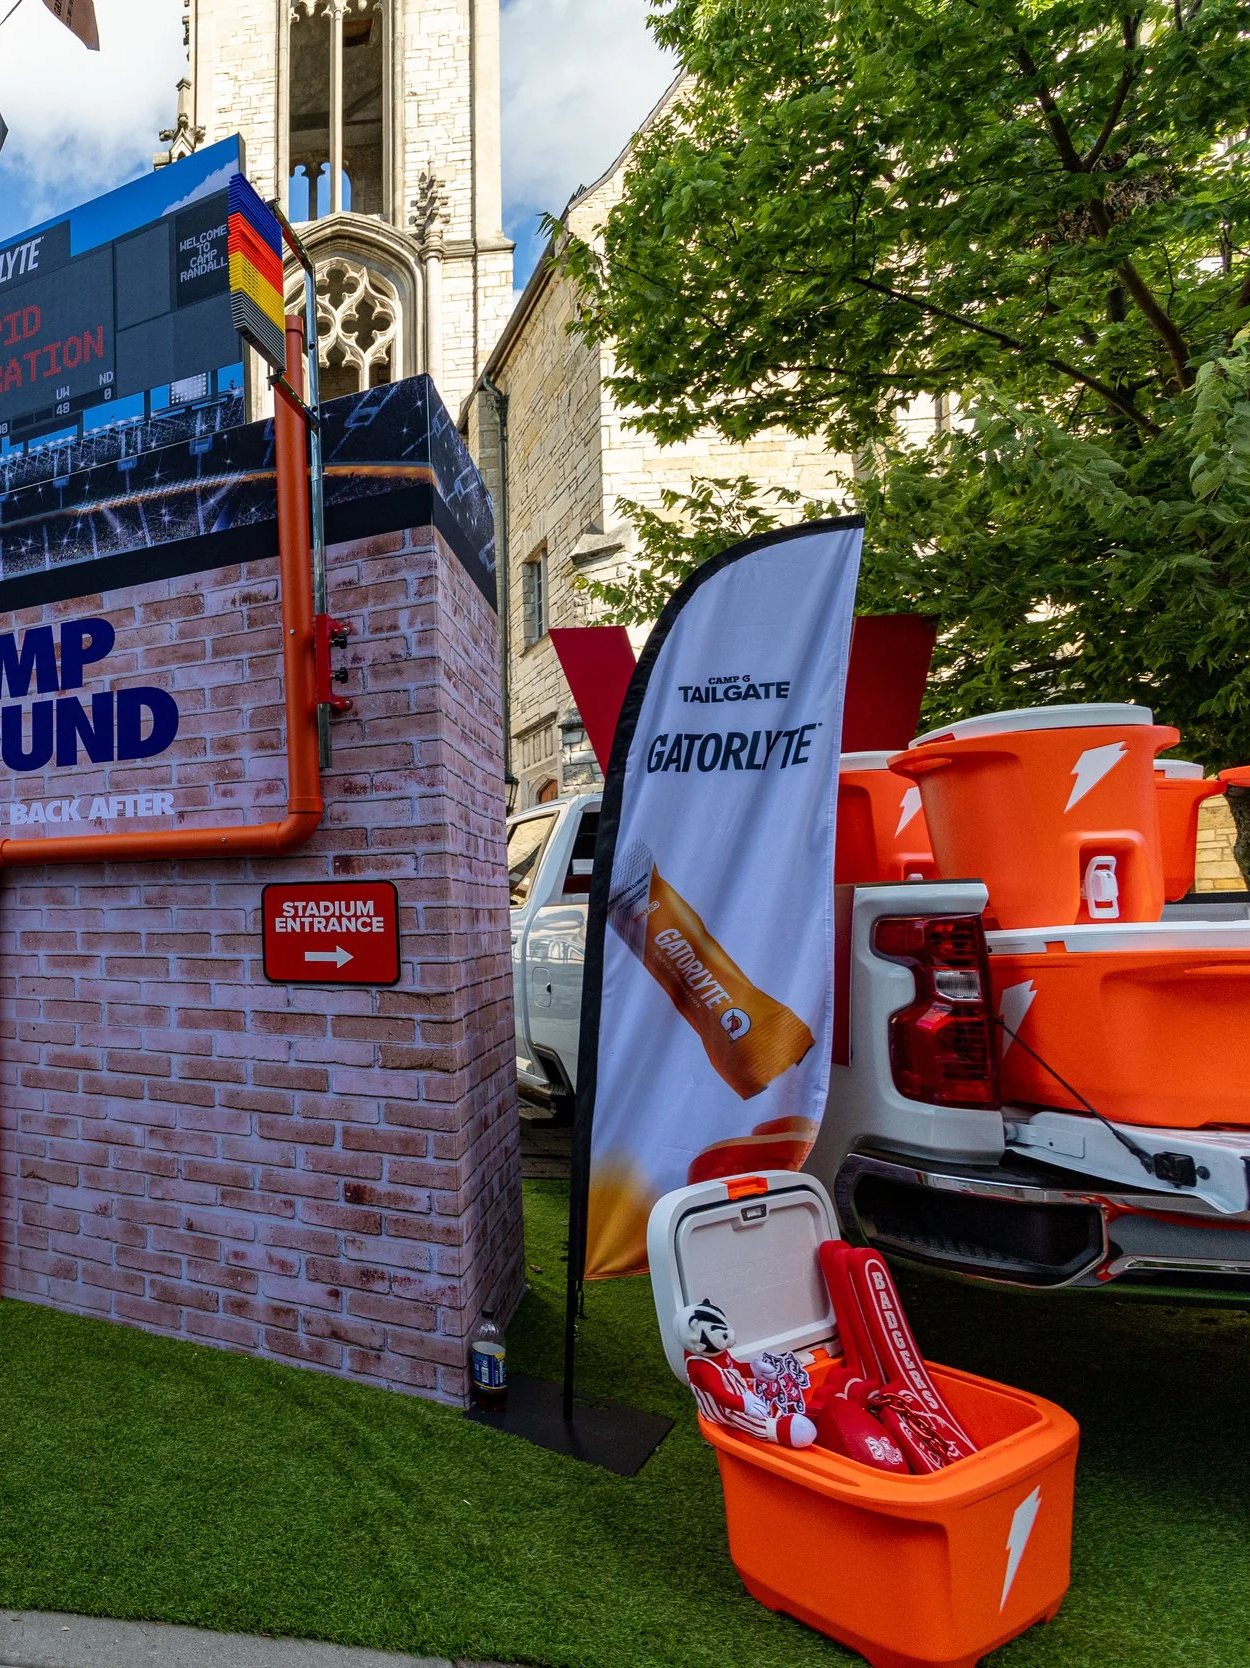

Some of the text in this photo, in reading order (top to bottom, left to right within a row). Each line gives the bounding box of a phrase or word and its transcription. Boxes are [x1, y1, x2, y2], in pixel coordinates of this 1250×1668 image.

[179, 224, 227, 252] WELCOME
[196, 241, 211, 255] TO
[190, 249, 218, 268] CAMP
[180, 256, 228, 283] RANDALL
[99, 371, 113, 386] ND
[56, 385, 70, 400] UW
[104, 388, 112, 400] 0
[56, 402, 70, 416] 48
[708, 674, 751, 685] CAMP G
[677, 681, 791, 704] TAILGATE
[646, 723, 818, 774] GATORLYTE
[10, 799, 81, 826] BACK
[87, 792, 176, 820] AFTER
[282, 900, 375, 917] STADIUM
[275, 917, 385, 933] ENTRANCE
[654, 928, 731, 1010] GATORLYTE
[871, 1271, 940, 1410] BADGERS
